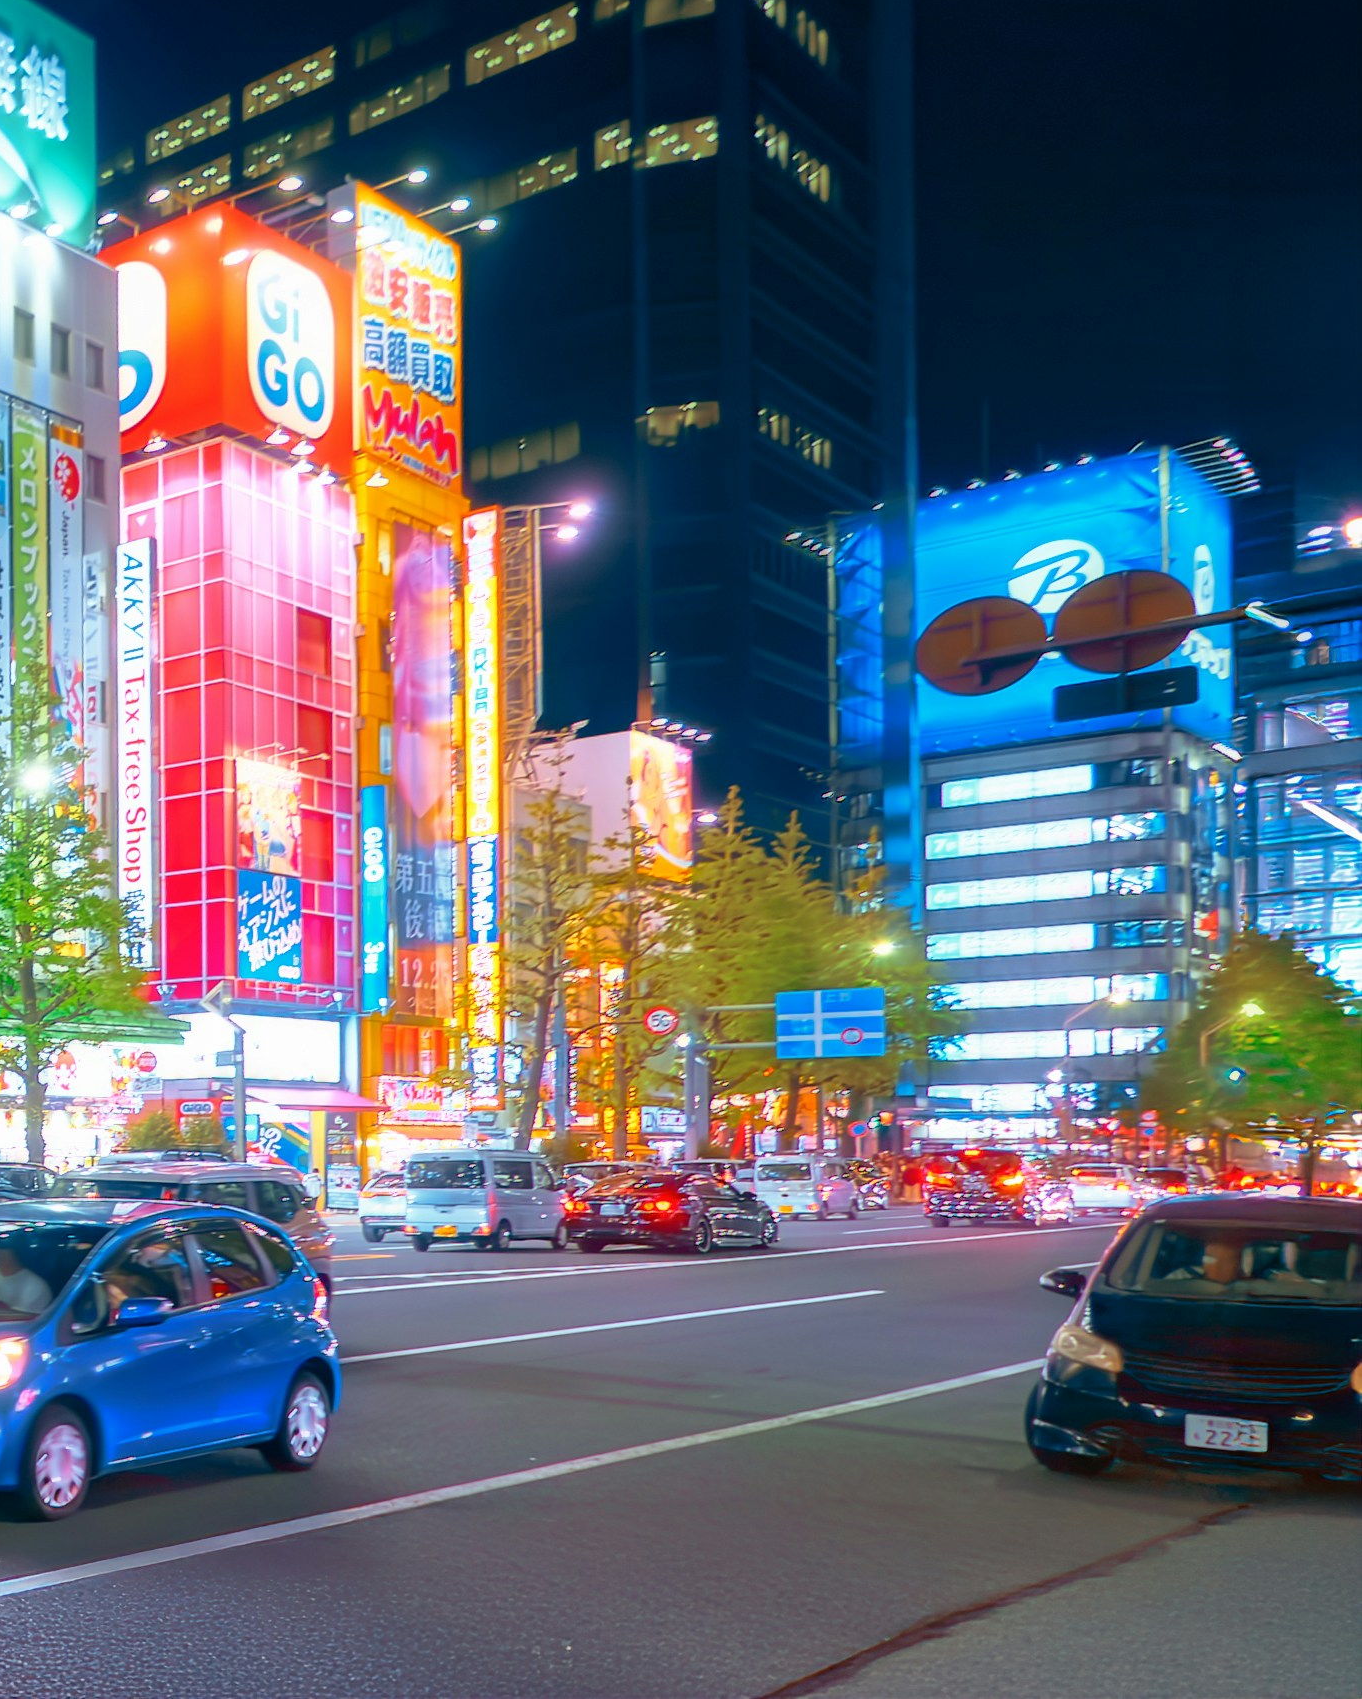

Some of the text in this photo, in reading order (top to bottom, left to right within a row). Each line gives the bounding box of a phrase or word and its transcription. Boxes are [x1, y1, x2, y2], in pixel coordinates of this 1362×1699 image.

[257, 339, 325, 422] GO
[363, 318, 454, 398] 高額買取
[123, 553, 145, 639] AKKY
[473, 647, 488, 714] AKIBA
[125, 669, 147, 800] Tax-free
[123, 806, 148, 883] Shop
